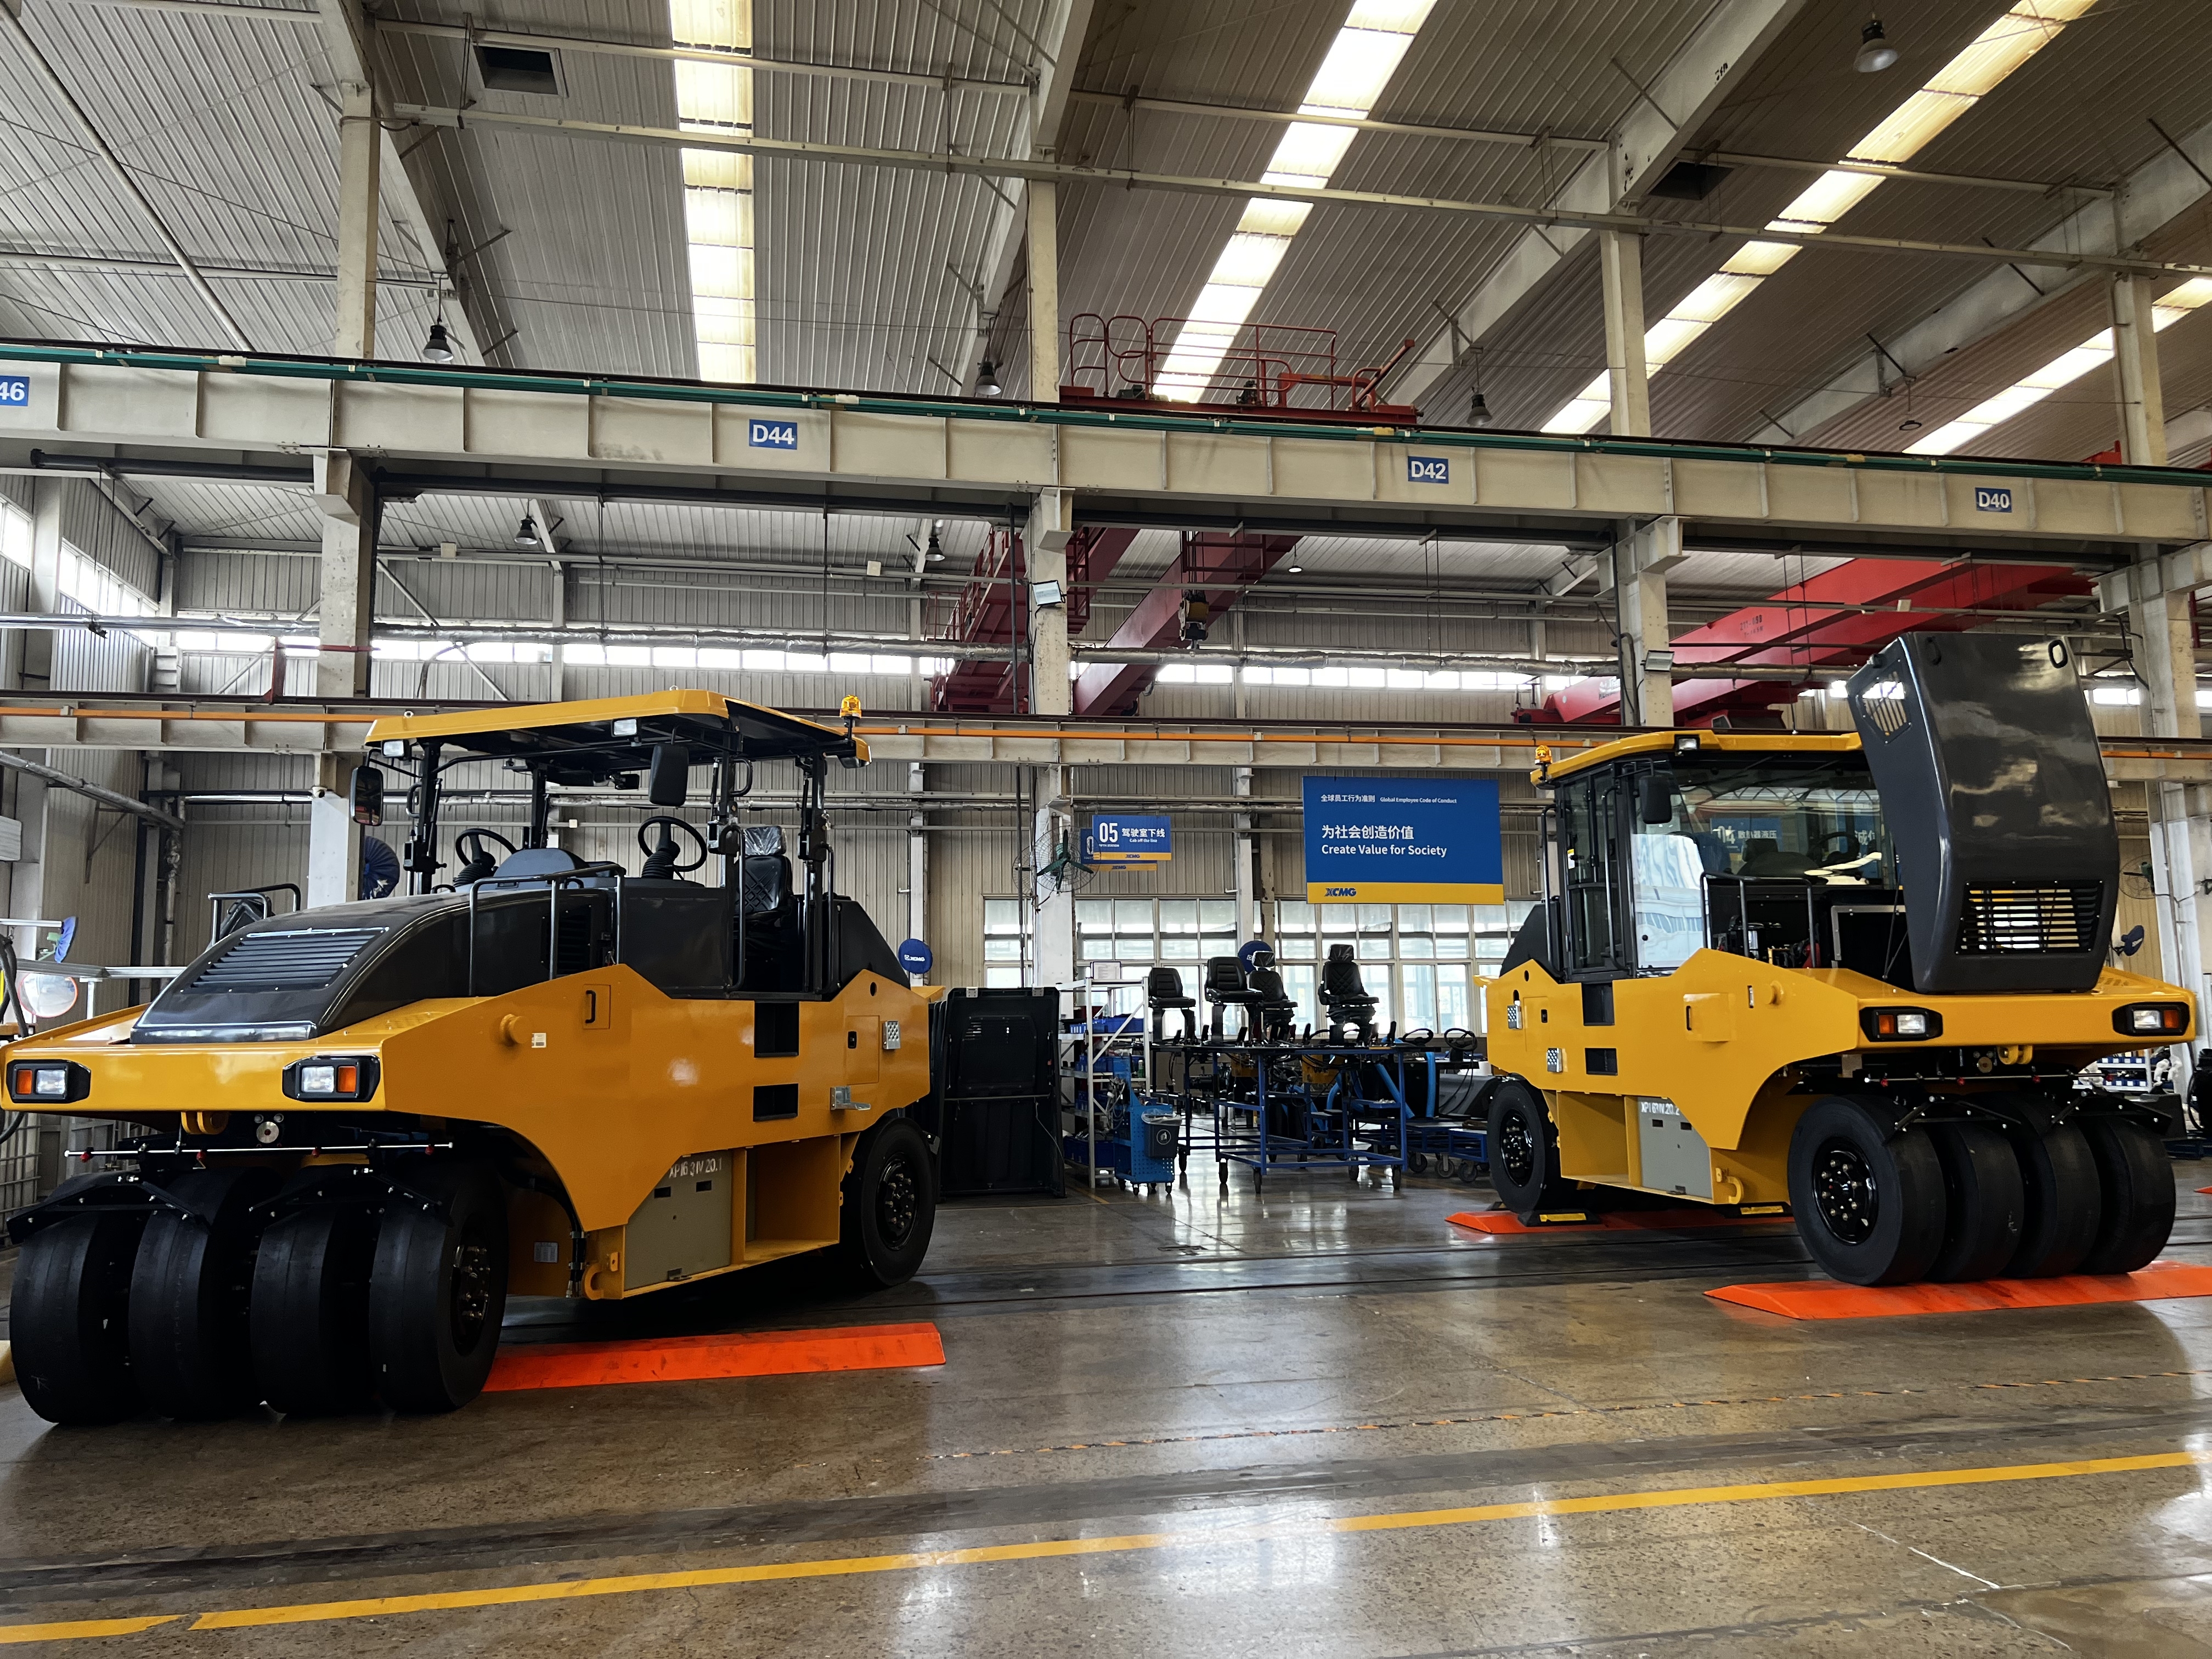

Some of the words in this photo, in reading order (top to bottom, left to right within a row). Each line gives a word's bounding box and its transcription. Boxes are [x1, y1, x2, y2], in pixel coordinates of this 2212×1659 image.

[753, 424, 795, 445] D44
[1411, 461, 1446, 479] D42
[1978, 492, 2010, 509] D40
[1321, 794, 1375, 803] 全球员工行为准则
[1099, 822, 1118, 843] 05
[1121, 828, 1165, 838] 驾驶室下线
[1322, 825, 1414, 839] 为社会创造价值
[1322, 844, 1356, 854] Create
[1358, 844, 1388, 854] Value
[1390, 845, 1406, 855] for
[1408, 845, 1447, 857] Society
[1324, 888, 1357, 897] XCMG
